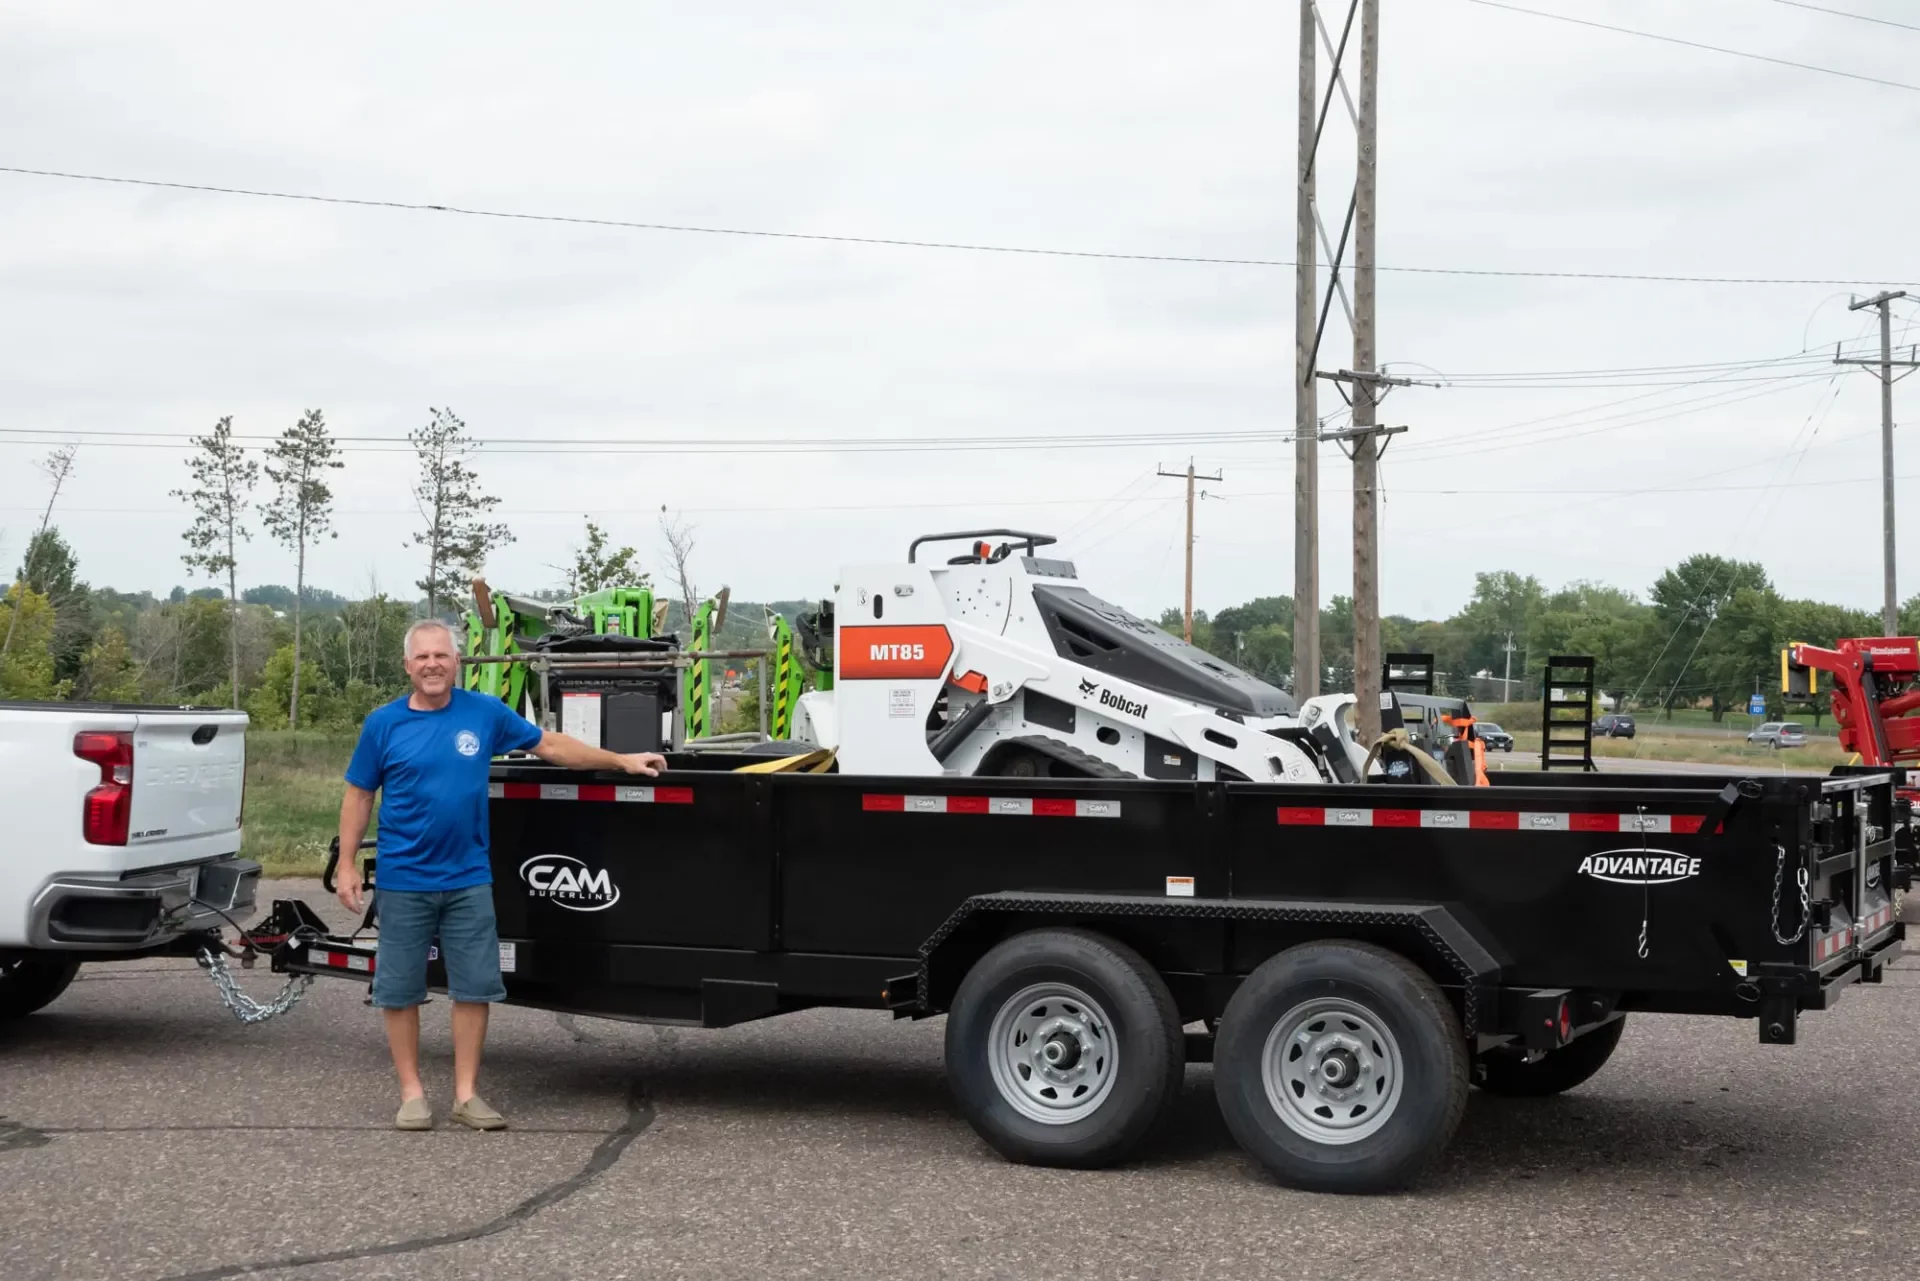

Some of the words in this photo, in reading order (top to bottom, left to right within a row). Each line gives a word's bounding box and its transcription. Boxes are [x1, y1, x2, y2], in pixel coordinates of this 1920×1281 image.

[870, 644, 924, 661] MT85
[1099, 688, 1148, 719] Bobcat
[1339, 813, 1358, 821] CAM
[1533, 817, 1554, 825] CAM
[1577, 856, 1702, 876] ADVANTAGE
[528, 864, 613, 895] CAM
[529, 889, 613, 901] SUPERLINE
